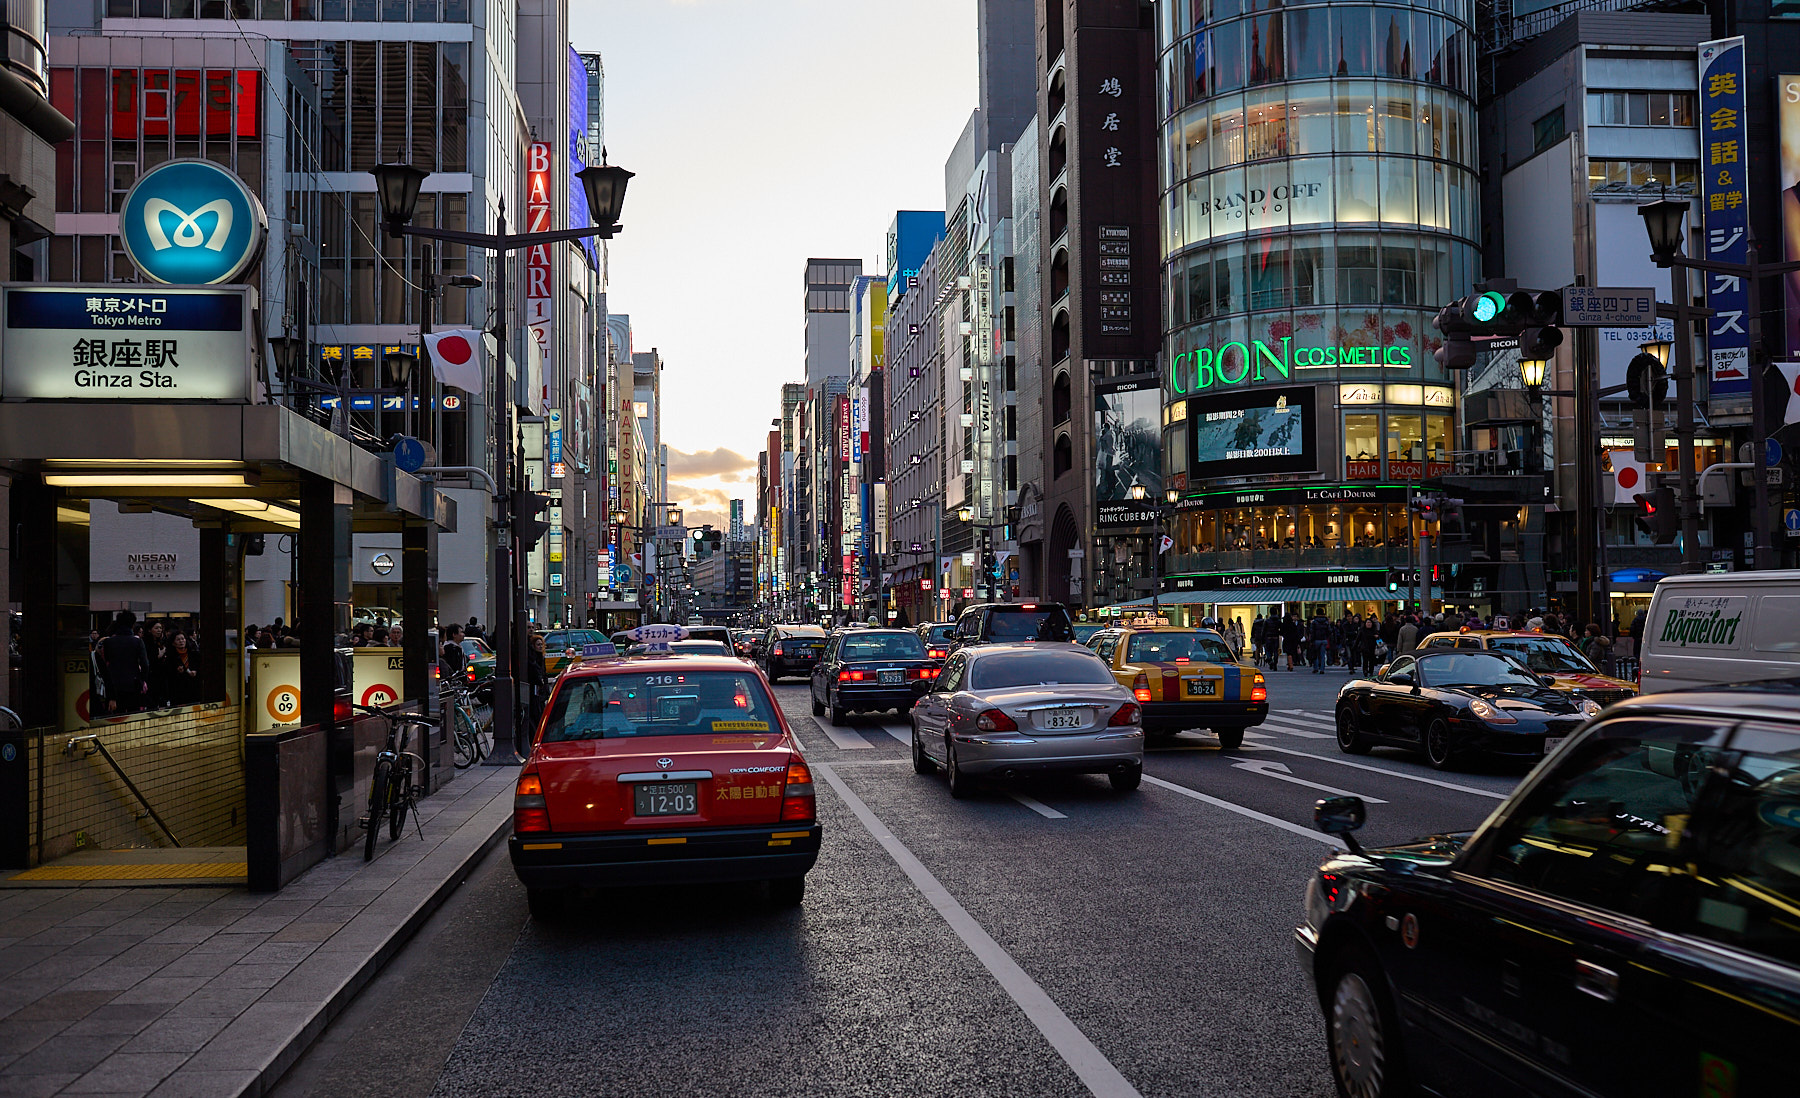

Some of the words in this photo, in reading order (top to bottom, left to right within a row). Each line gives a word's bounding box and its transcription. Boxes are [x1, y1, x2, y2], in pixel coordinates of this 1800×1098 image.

[1098, 77, 1122, 168] 鳩居堂
[1201, 188, 1266, 217] BRAND
[1273, 182, 1322, 201] OFF
[1225, 204, 1283, 221] TOKYO
[528, 143, 550, 297] BAZAR
[1710, 228, 1746, 335] ジオス
[1569, 288, 1595, 296] 中央区
[85, 297, 167, 313] 東京メトロ
[1570, 297, 1650, 313] 銀座四丁目
[91, 314, 126, 327] Tokyo
[128, 314, 162, 326] Metro
[1578, 313, 1602, 322] Ginza
[1605, 313, 1642, 322] 4-chome
[1604, 332, 1622, 341] TEL
[1491, 340, 1518, 349] RICOH
[72, 337, 180, 370] 銀座駅
[1294, 346, 1412, 366] COSMETICS
[1172, 336, 1292, 394] C'BON
[74, 369, 134, 389] Ginza
[139, 370, 178, 388] Sta.
[1117, 383, 1138, 391] RICOH
[445, 398, 457, 406] 4F
[982, 380, 990, 432] SHIMA
[1350, 465, 1378, 475] HAIR
[1391, 465, 1421, 476] SALON
[1307, 490, 1319, 499] LE
[1343, 489, 1376, 498] DOUTOR
[1184, 499, 1204, 507] DOUTOR
[1099, 506, 1129, 514] フォトギャラリー
[1099, 513, 1118, 523] RING
[1119, 512, 1140, 522] CUBE
[128, 554, 177, 563] NISSAN
[128, 563, 176, 571] GALLERY
[1222, 576, 1232, 585] LE
[1252, 575, 1283, 584] DOUTOR
[1660, 609, 1742, 646] Roquefort
[644, 629, 673, 639] チェッカー
[646, 675, 673, 685] 216
[885, 675, 902, 683] 52-23
[1193, 685, 1215, 694] 90-24
[281, 693, 290, 702] G
[375, 693, 385, 701] M
[278, 702, 293, 712] 09
[1052, 716, 1080, 727] 83-24
[649, 785, 667, 795] 足立
[667, 784, 684, 794] 500
[716, 785, 781, 800] 太陽自動車
[649, 795, 695, 813] 12-03
